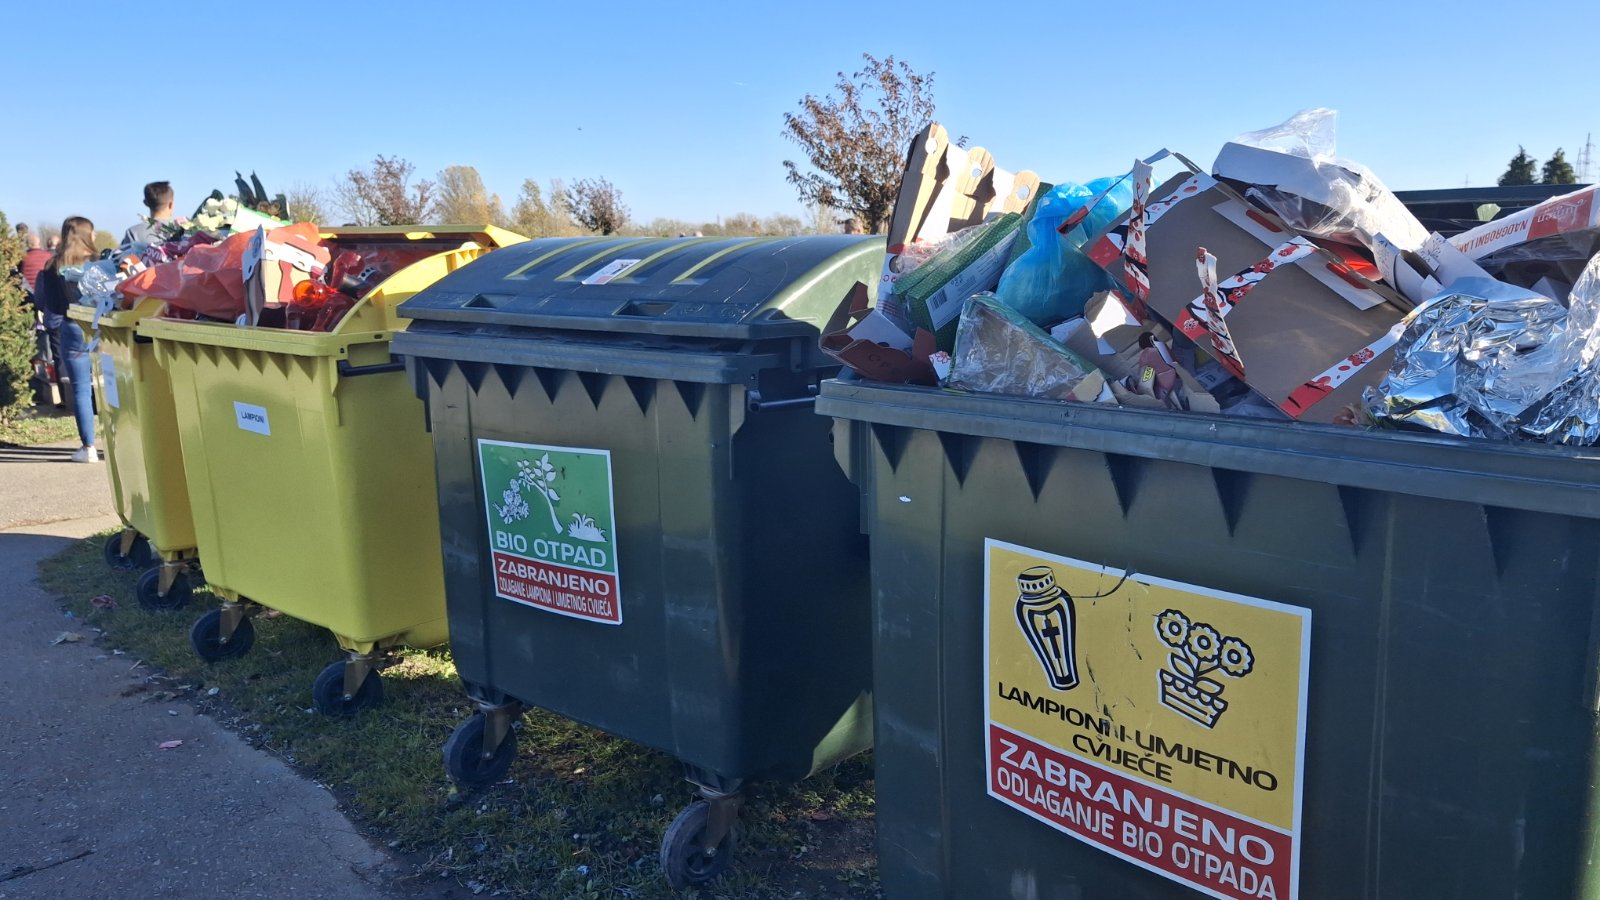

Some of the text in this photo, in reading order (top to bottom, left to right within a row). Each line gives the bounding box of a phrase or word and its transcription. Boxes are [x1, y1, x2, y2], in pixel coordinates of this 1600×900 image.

[1474, 219, 1529, 249] NADGROBNI
[495, 530, 607, 567] BIO OTPAD
[498, 558, 610, 596] ZABRANJENO
[499, 577, 526, 597] ODLAGANJE
[526, 585, 552, 605] LAMPIONA
[556, 593, 587, 612] UMJETNOG
[587, 598, 613, 617] CVIJEĆA
[998, 681, 1278, 792] LAMPIONI I UMJETNO
[999, 737, 1275, 866] ZABRANJENO
[997, 767, 1278, 900] ODLAGANJE BIO OTPADA
